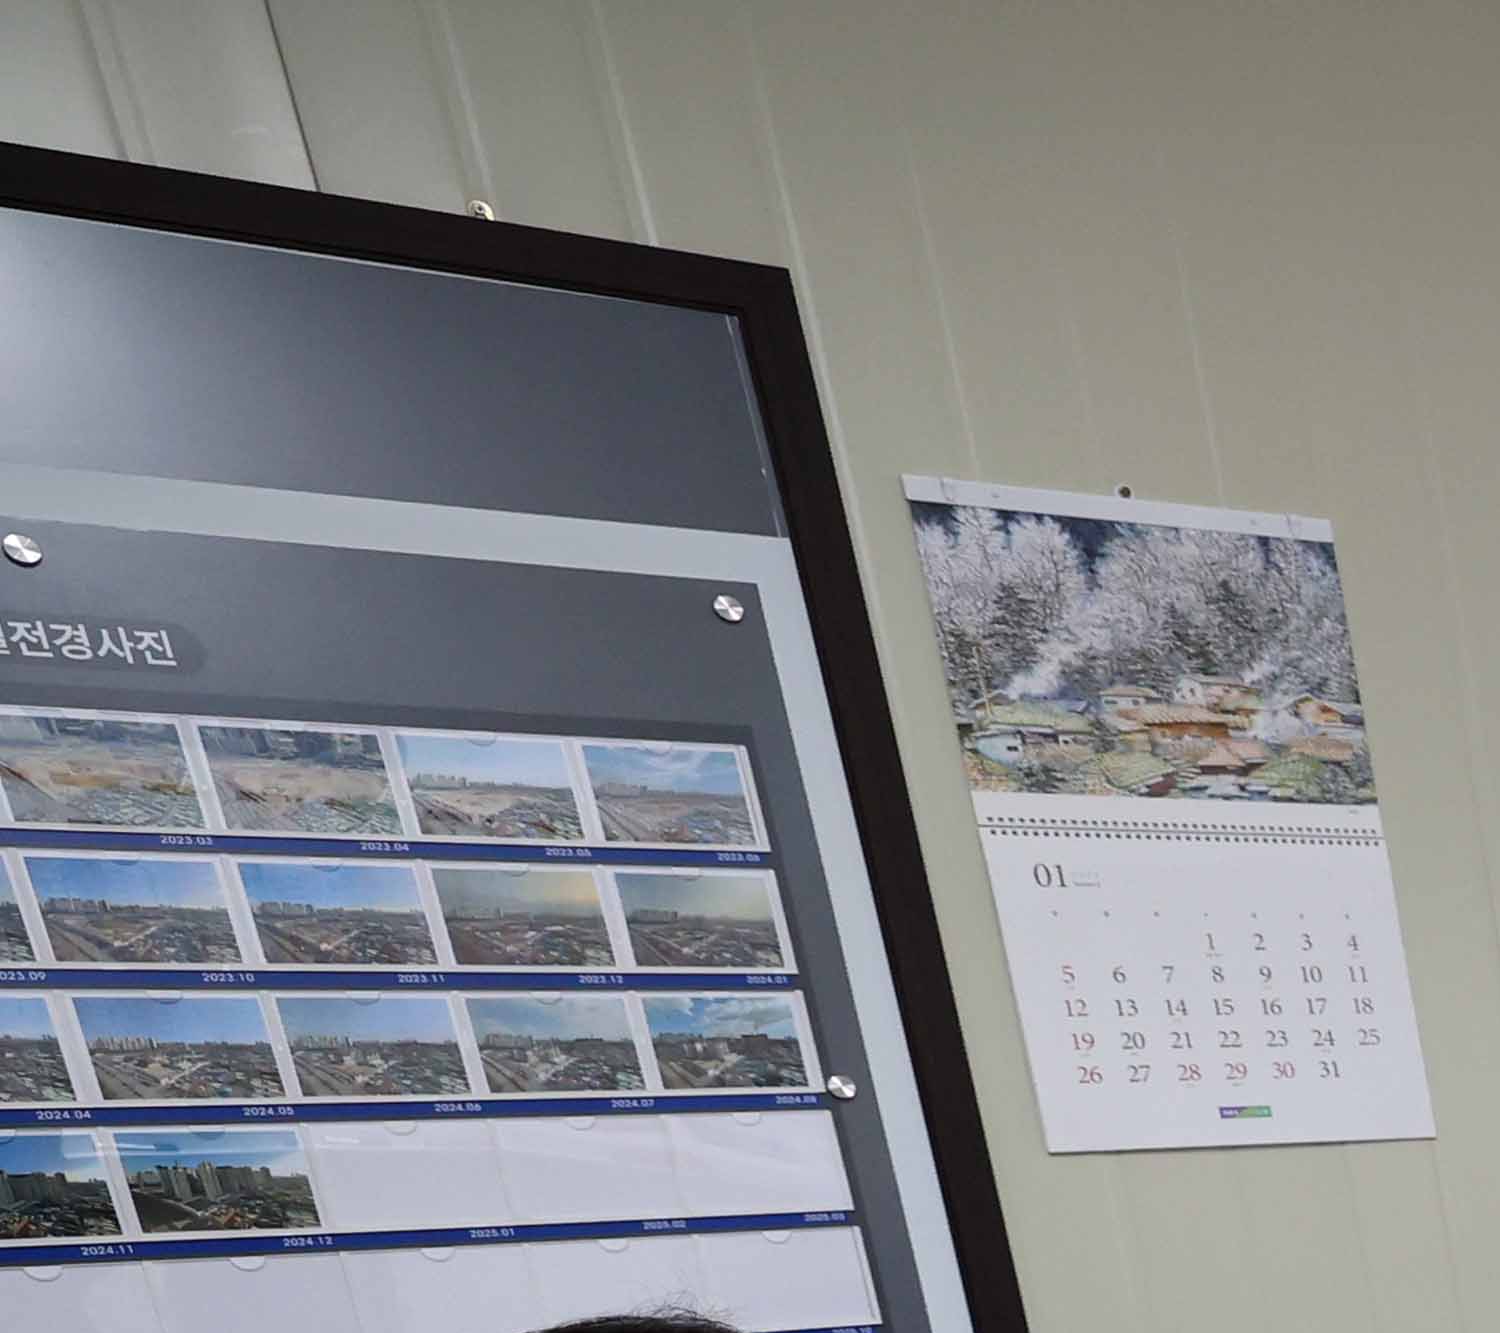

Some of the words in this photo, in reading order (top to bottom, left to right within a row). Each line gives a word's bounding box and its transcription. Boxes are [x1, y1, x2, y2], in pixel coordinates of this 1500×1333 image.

[0, 620, 178, 667] 전경사진
[360, 841, 410, 853] 2023.04
[1033, 863, 1067, 888] 01
[1206, 933, 1215, 950] 1
[1254, 933, 1266, 951] 2
[1302, 934, 1312, 951] 3
[1348, 936, 1359, 951] 4
[202, 971, 256, 984] 2023.10
[1062, 965, 1075, 984] 5
[1113, 966, 1126, 983] 6
[1162, 966, 1174, 983] 7
[1212, 966, 1224, 982] 8
[1259, 966, 1272, 982] 9
[1301, 966, 1322, 983] 10
[1348, 966, 1368, 983] 11
[1065, 999, 1088, 1017] 12
[1115, 999, 1138, 1016] 13
[1166, 1000, 1188, 1016] 14
[1213, 998, 1234, 1015] 15
[1261, 999, 1282, 1015] 16
[1306, 998, 1326, 1015] 17
[1353, 998, 1374, 1014] 18
[1072, 1033, 1095, 1050] 19
[1121, 1032, 1145, 1050] 20
[1171, 1032, 1192, 1048] 21
[1218, 1031, 1242, 1048] 22
[1266, 1030, 1288, 1047] 23
[1313, 1030, 1335, 1046] 24
[1358, 1028, 1380, 1045] 25
[1078, 1066, 1103, 1084] 26
[1128, 1065, 1150, 1083] 27
[1178, 1064, 1202, 1081] 28
[1225, 1063, 1248, 1080] 29
[1273, 1062, 1295, 1079] 30
[1320, 1061, 1340, 1078] 31
[36, 1109, 92, 1121] 2024.04
[80, 1244, 135, 1257] 2024.11
[283, 1236, 334, 1248] 2024.12
